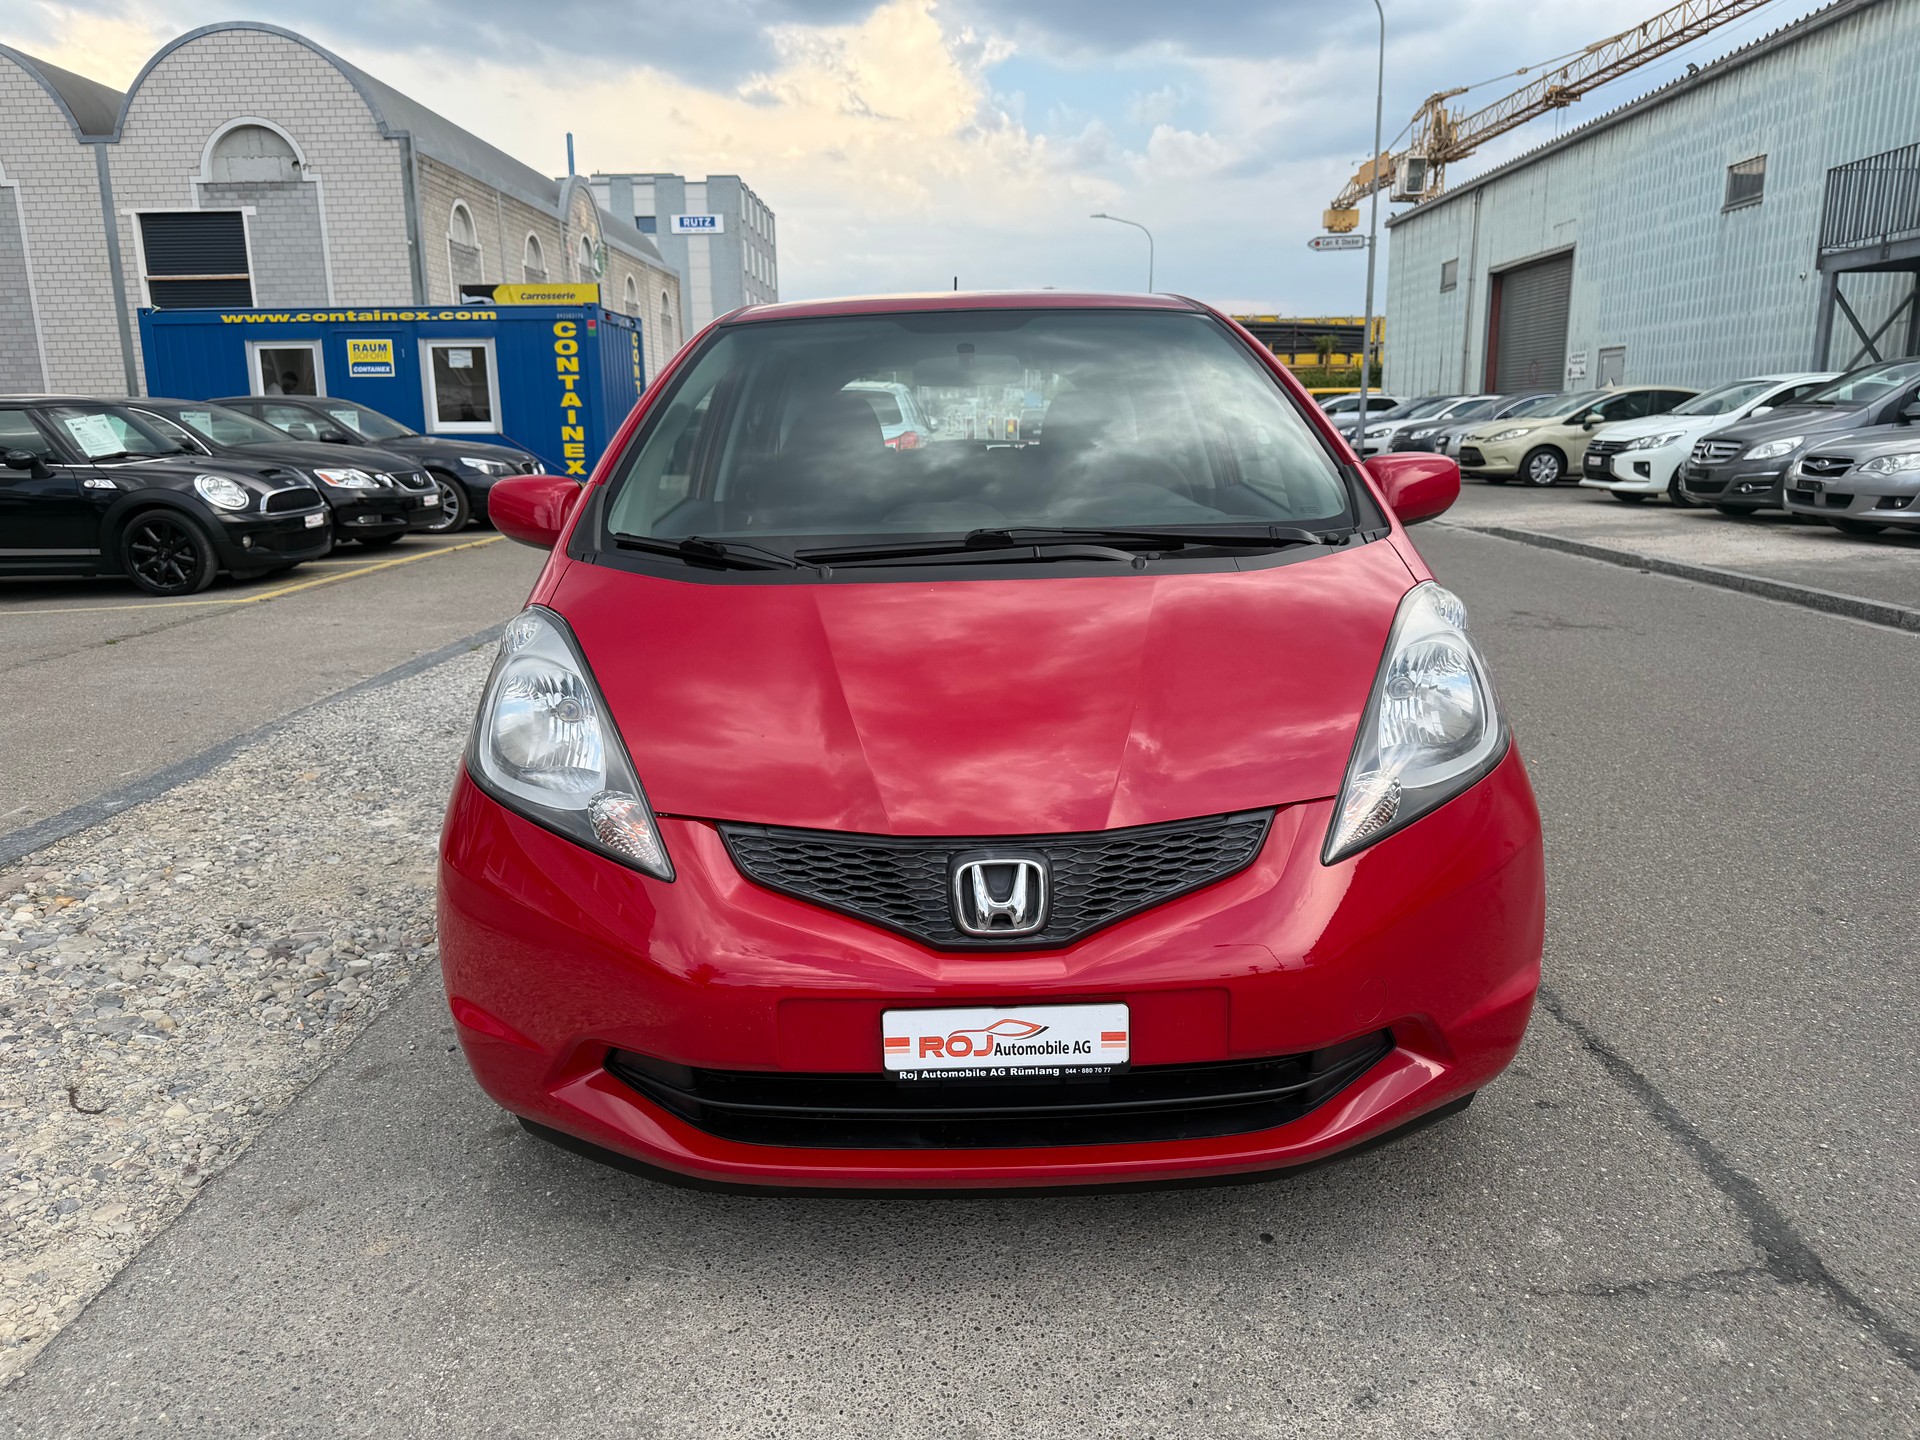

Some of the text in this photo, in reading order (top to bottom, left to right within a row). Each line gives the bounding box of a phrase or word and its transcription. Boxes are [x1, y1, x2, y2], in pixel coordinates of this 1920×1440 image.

[683, 217, 711, 227] RUTZ
[520, 292, 576, 300] Carrosserie
[221, 310, 497, 324] www.containex.com
[353, 344, 388, 352] RAUM
[353, 352, 388, 361] SOFORT
[631, 332, 641, 400] CONT
[553, 321, 587, 475] CONTAINEX
[918, 1035, 1091, 1059] ROJ Automobile AG
[900, 1070, 918, 1081] Roj
[921, 1068, 987, 1079] Automobile
[990, 1068, 1006, 1077] AG
[1010, 1067, 1060, 1076] Rümlang
